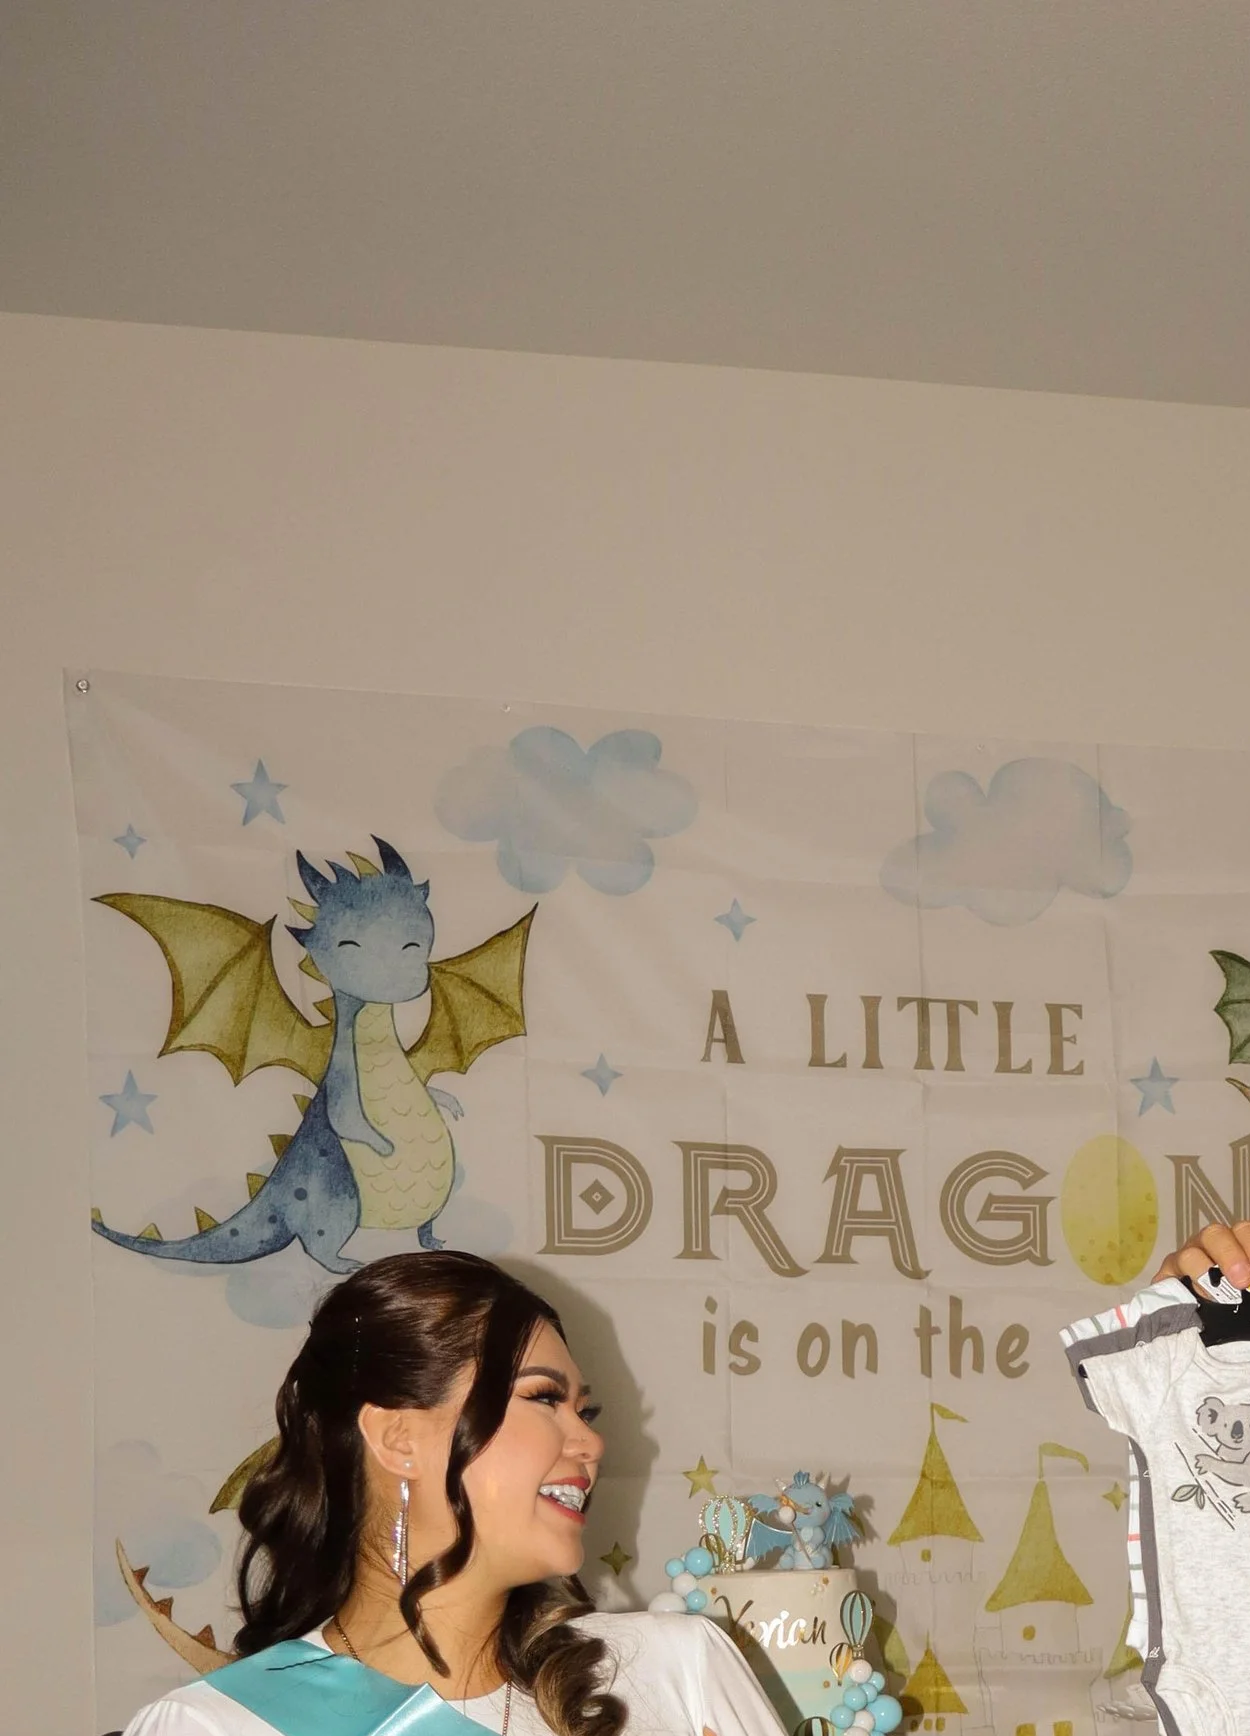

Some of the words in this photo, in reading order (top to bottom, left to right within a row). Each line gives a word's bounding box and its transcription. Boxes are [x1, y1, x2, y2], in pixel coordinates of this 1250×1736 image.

[700, 989, 747, 1065] A
[806, 993, 1085, 1077] LITTLE
[701, 1296, 761, 1377] is
[796, 1318, 880, 1379] on
[914, 1295, 1031, 1380] the
